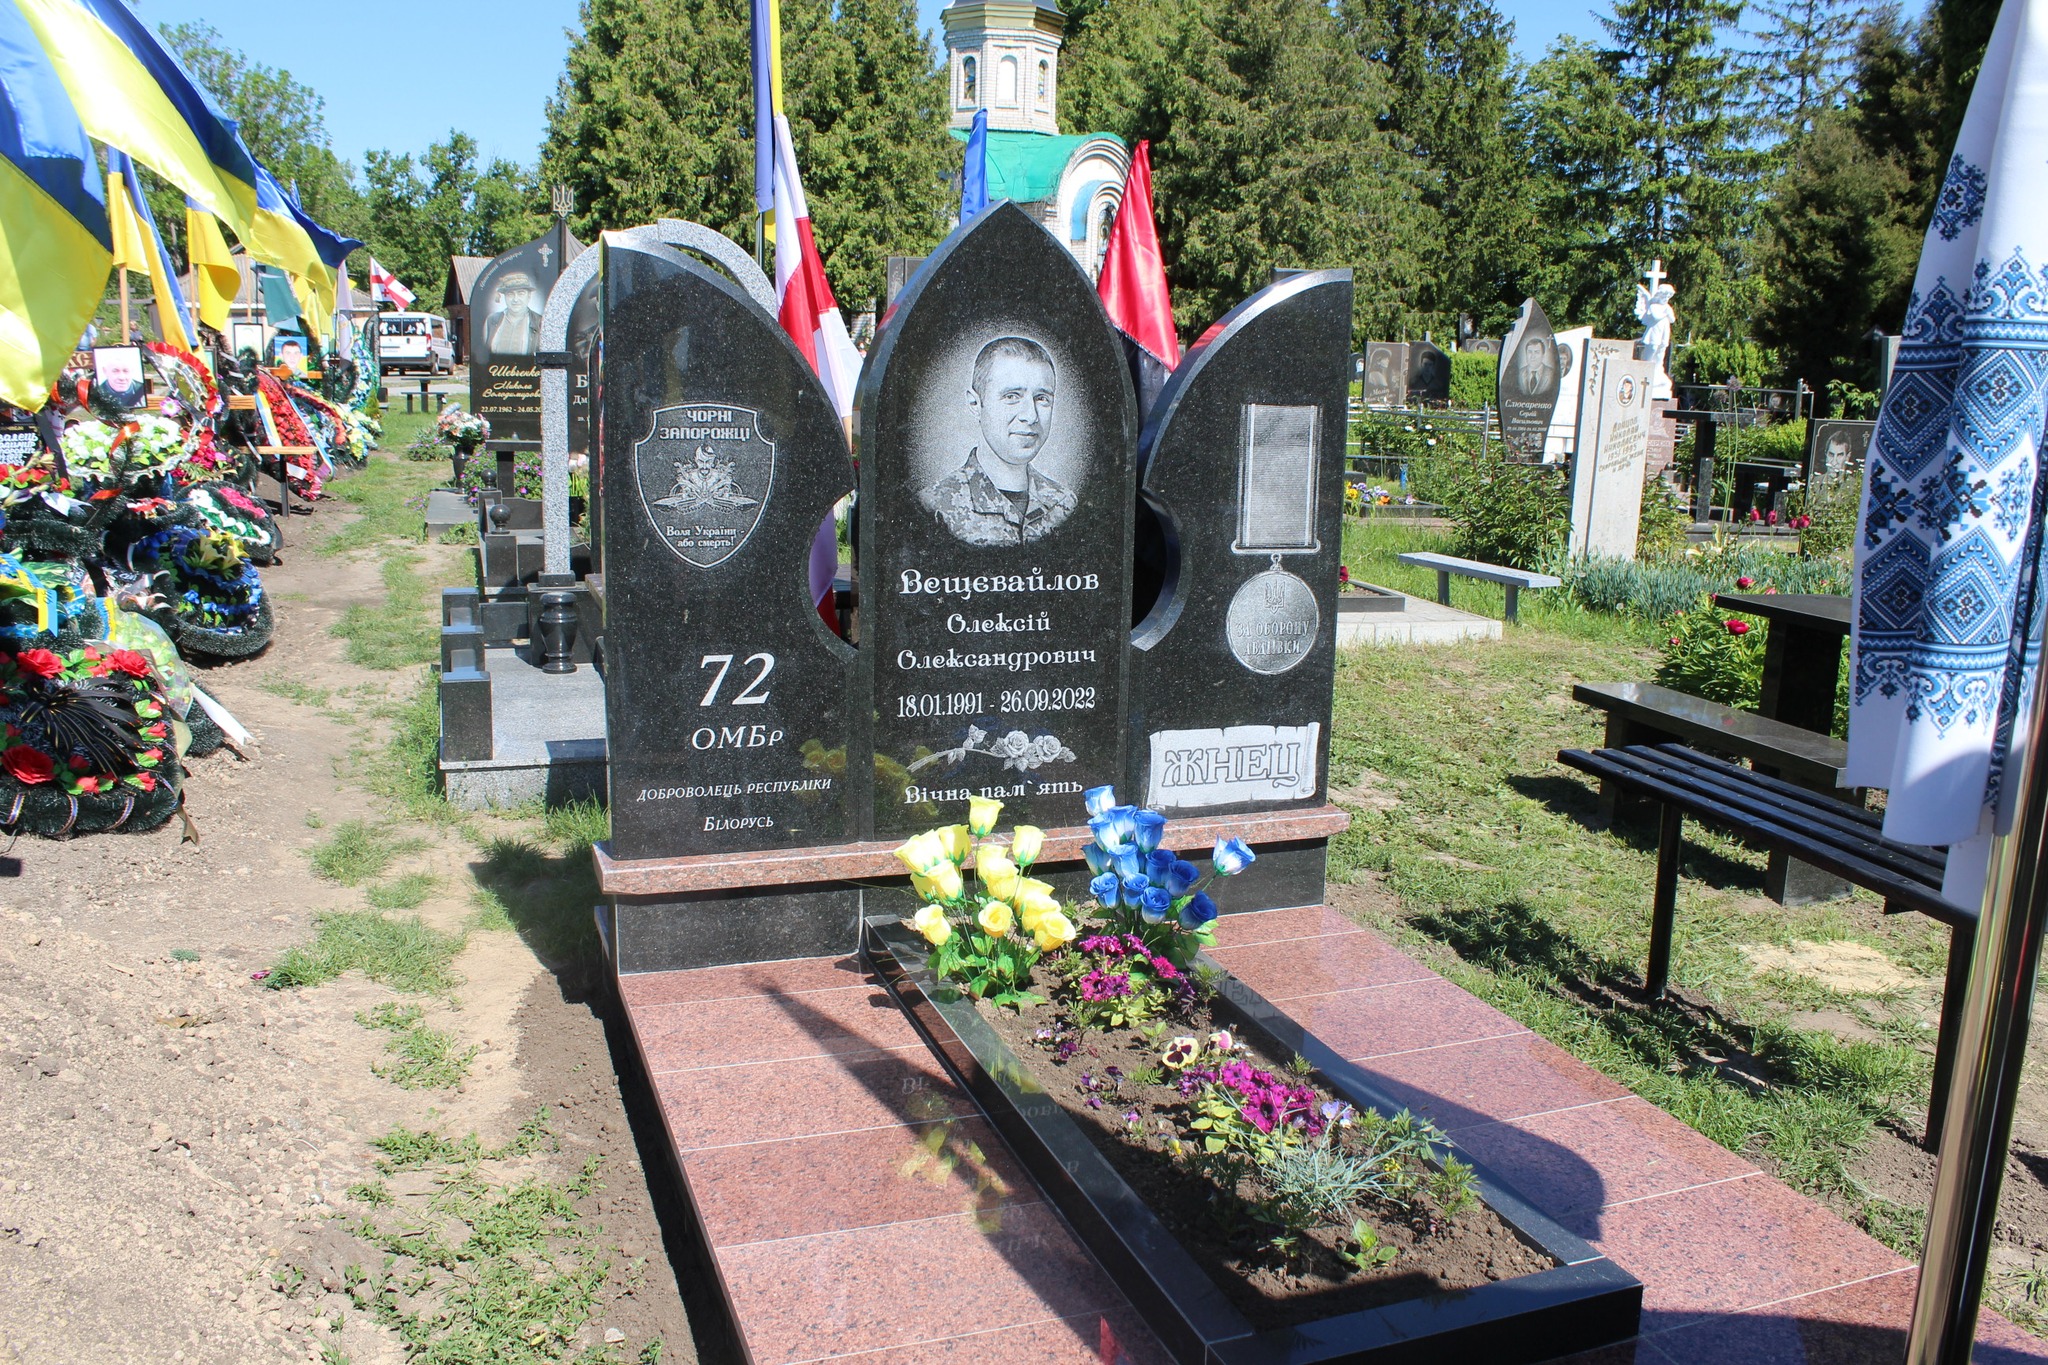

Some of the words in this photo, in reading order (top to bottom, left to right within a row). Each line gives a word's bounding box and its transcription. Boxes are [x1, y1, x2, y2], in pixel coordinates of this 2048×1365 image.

[1504, 399, 1552, 410] Слюсаренко
[686, 409, 733, 423] ЧОРНІ
[659, 427, 751, 441] ЗАПОРОЖЦІ
[666, 525, 691, 537] Воля
[677, 537, 694, 548] або
[697, 537, 735, 549] смерть!
[946, 611, 1052, 634] Олексій
[1235, 621, 1252, 638] ЗА
[1255, 620, 1310, 637] ОБОРОНУ
[896, 648, 1097, 673] Олександрович
[700, 652, 776, 707] 72
[896, 692, 984, 718] 18.01.1991
[1000, 687, 1096, 714] 26.09.2022
[1161, 742, 1301, 789] ЖНЕЦ
[636, 784, 742, 802] ДОБРОВОЛЕЦЬ
[747, 778, 832, 794] РЕСПУБЛІКИ
[904, 785, 972, 804] Вічна
